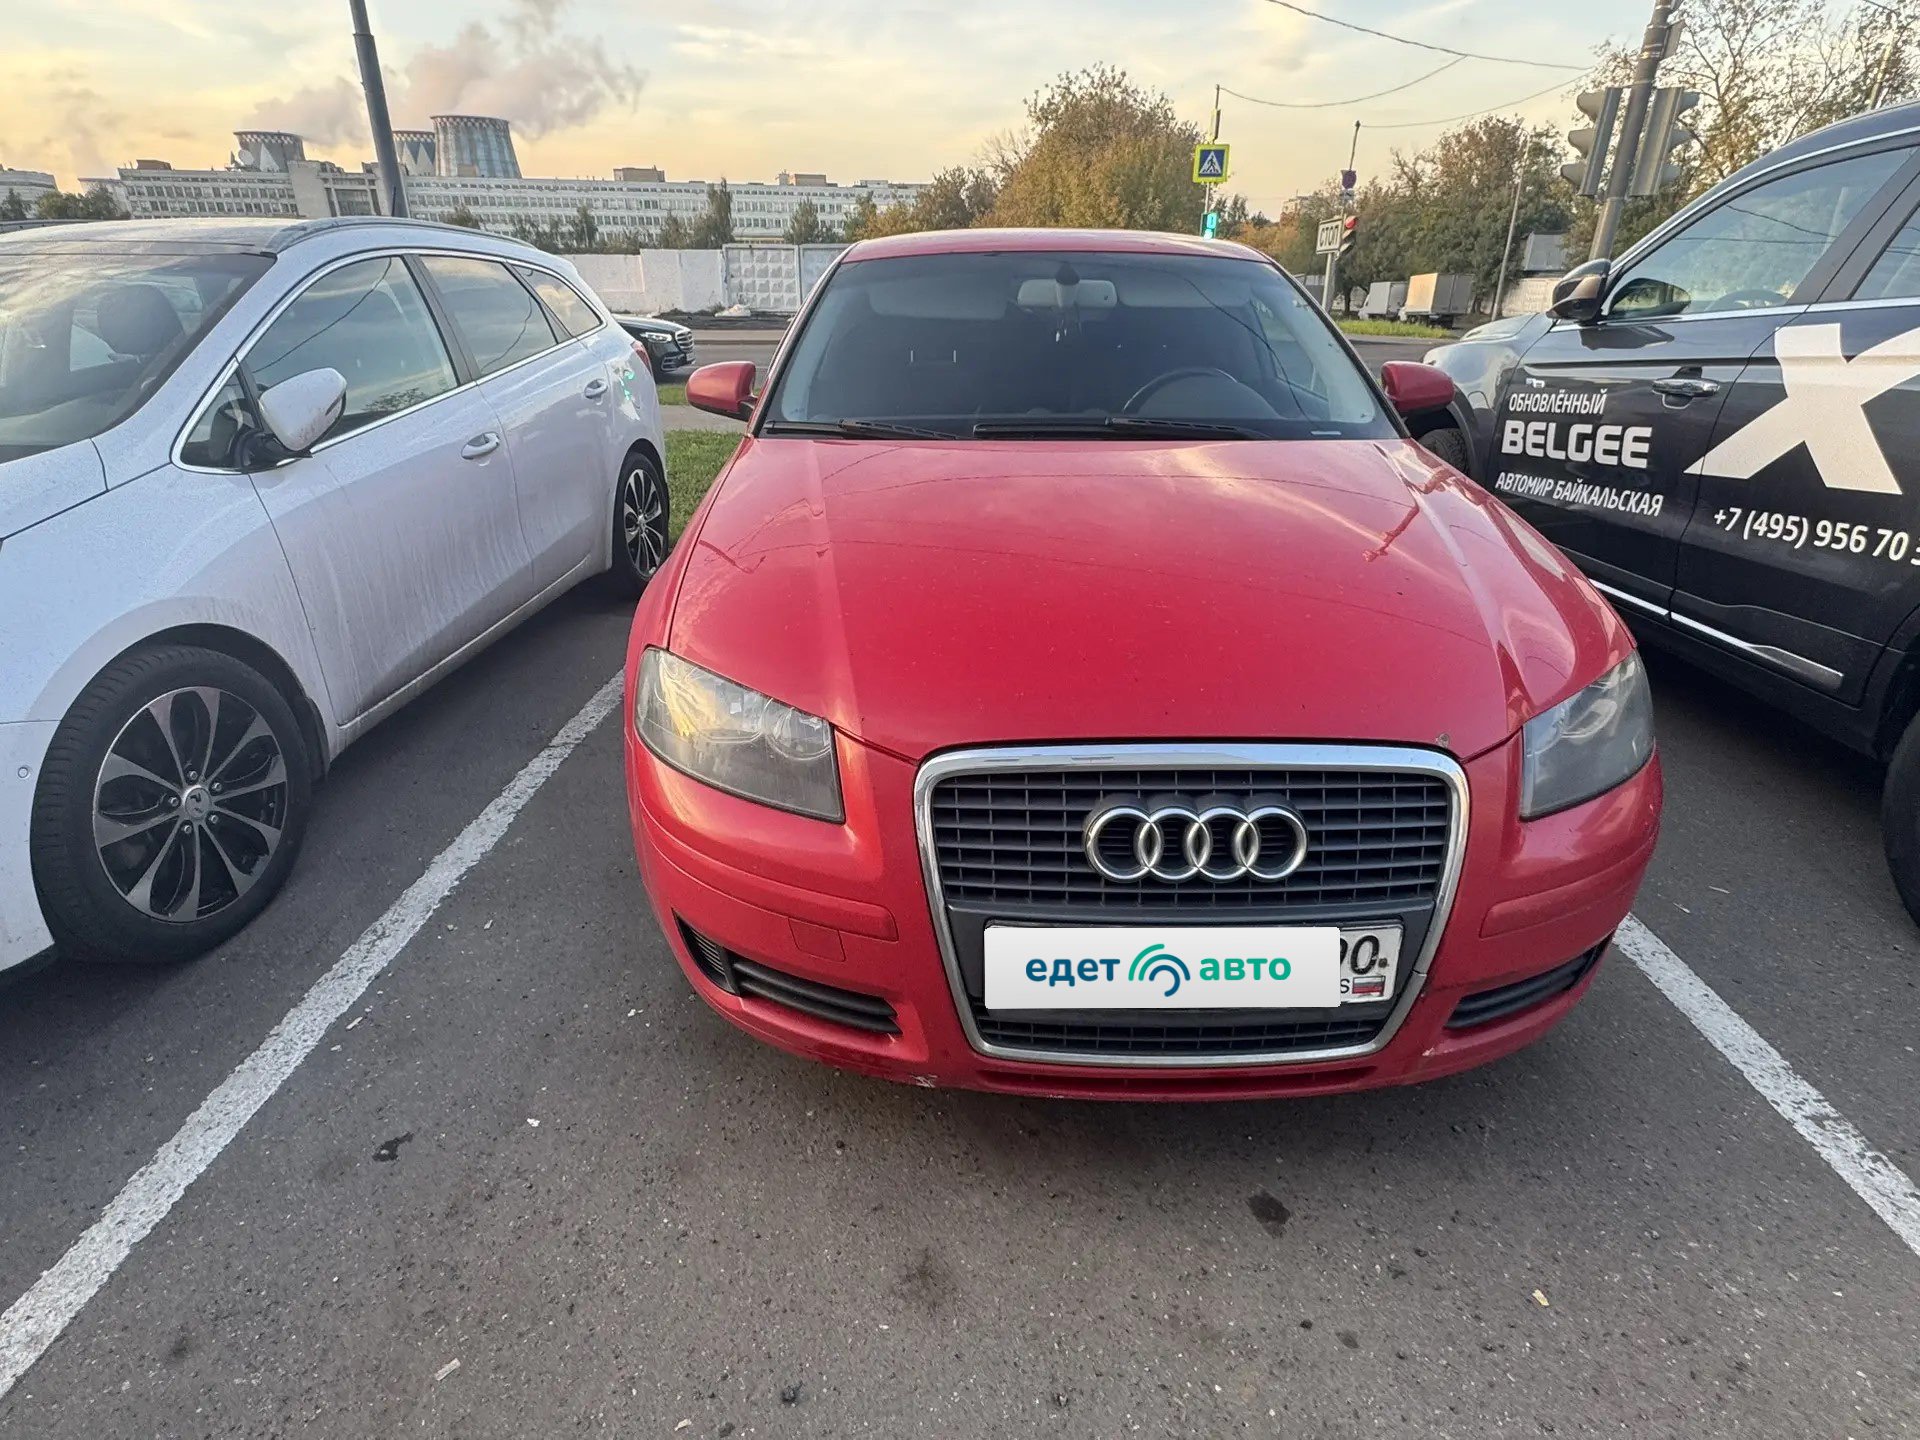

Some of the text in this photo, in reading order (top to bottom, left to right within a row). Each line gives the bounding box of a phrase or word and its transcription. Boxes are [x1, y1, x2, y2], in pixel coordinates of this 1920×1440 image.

[1320, 225, 1339, 247] СТОП
[1509, 389, 1607, 414] ОБНОВЛЁННЫЙ
[1501, 420, 1652, 468] BELGEE
[1495, 472, 1664, 518] АВТОМИР БАЙКАЛЬСКАЯ
[1714, 507, 1742, 531] +7
[1743, 510, 1809, 549] (495)
[1813, 520, 1868, 553] 956
[1872, 528, 1910, 561] 70
